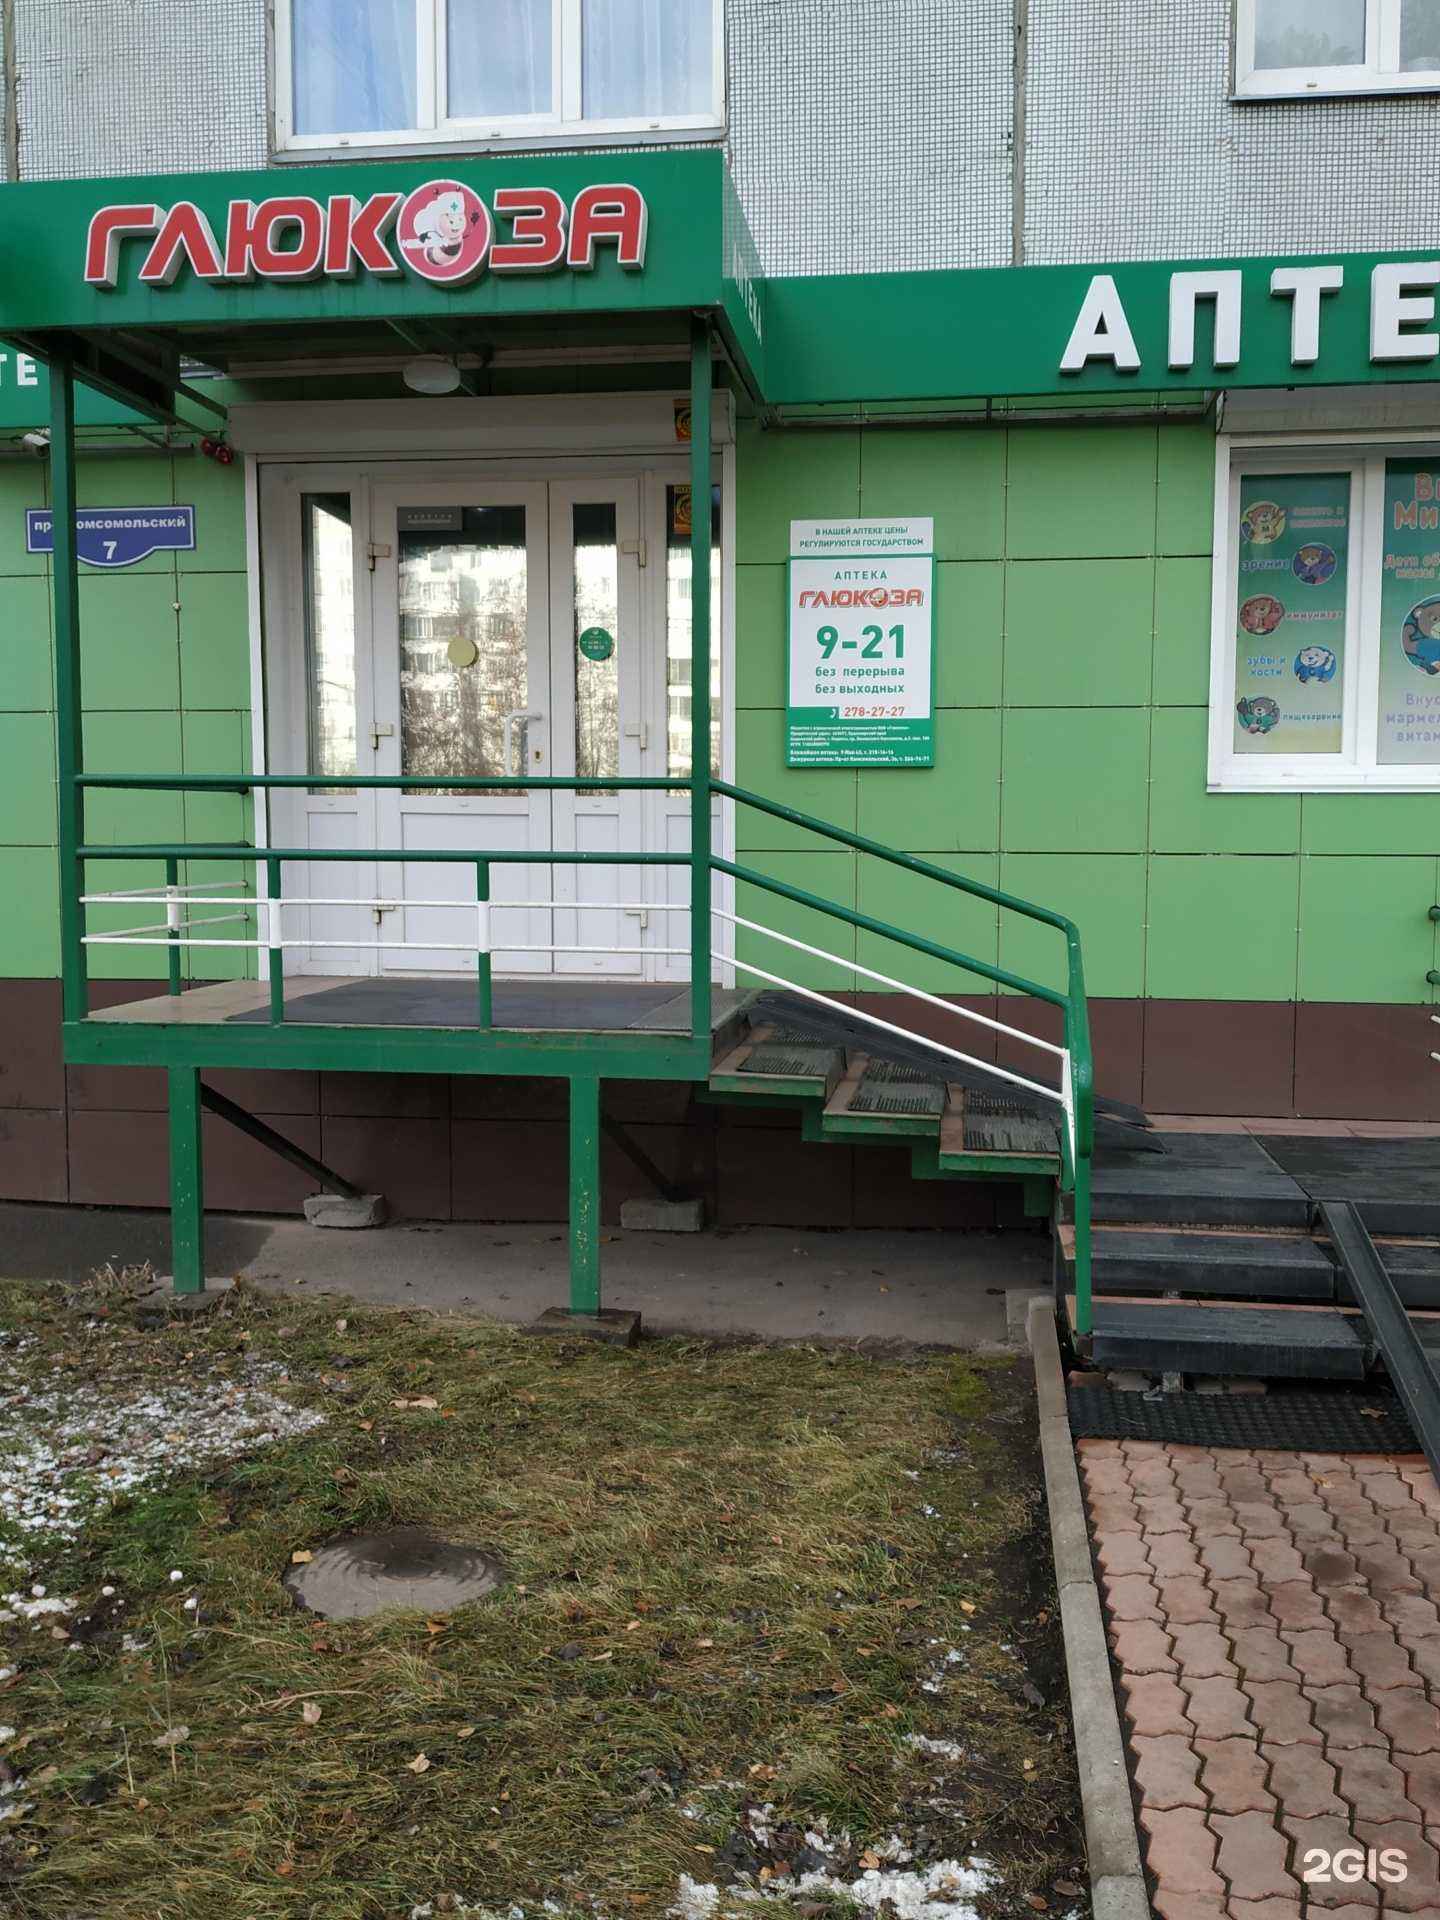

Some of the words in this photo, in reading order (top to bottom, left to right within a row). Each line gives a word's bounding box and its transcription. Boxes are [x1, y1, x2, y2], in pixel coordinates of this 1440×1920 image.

[76, 515, 187, 530] омсомольский
[822, 526, 852, 536] НАШЕЙ
[853, 527, 882, 536] АПТЕКЕ
[885, 526, 908, 536] ЦЕНЫ
[800, 539, 861, 548] РЕГУЛИРУЮТСЯ
[863, 538, 924, 547] ГОСУДАРСТВОМ
[102, 541, 118, 560] 7
[834, 570, 888, 580] АПТЕКА
[816, 624, 905, 659] 9-21
[815, 666, 836, 677] без
[843, 667, 905, 678] перерыва
[815, 683, 836, 694] без
[839, 684, 905, 694] выходных
[844, 706, 905, 717] 278-27-27
